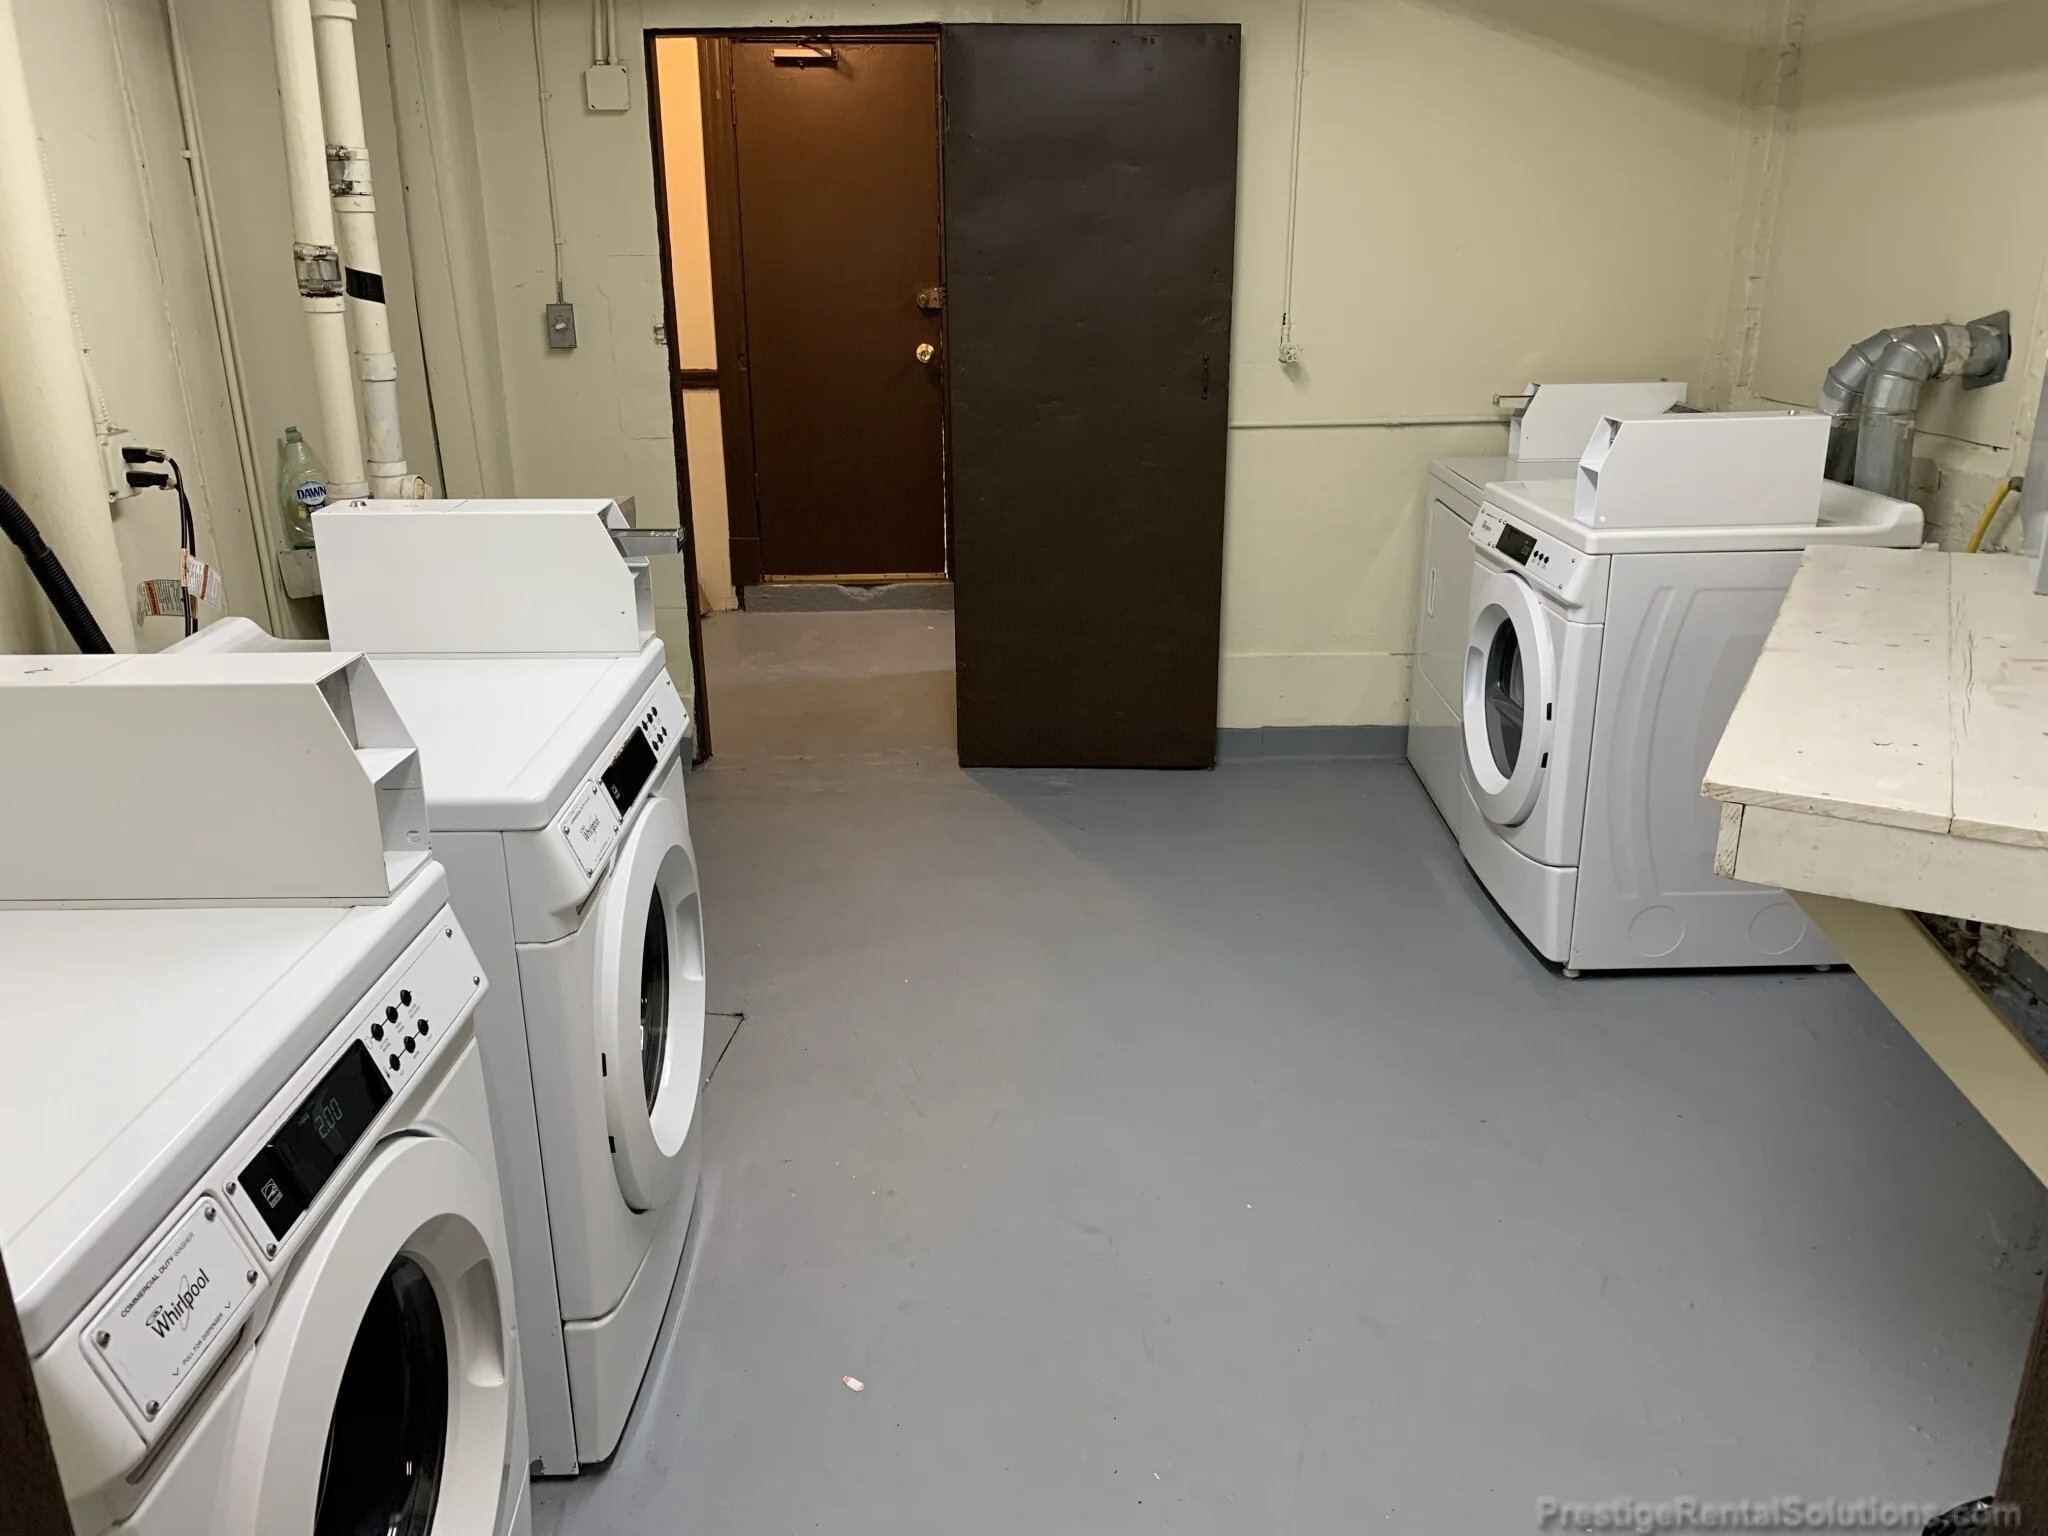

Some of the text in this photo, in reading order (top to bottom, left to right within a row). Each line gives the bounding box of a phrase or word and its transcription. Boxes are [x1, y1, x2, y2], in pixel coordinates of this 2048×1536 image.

[296, 485, 327, 500] DAWN
[315, 1098, 342, 1138] 2.00
[121, 1232, 195, 1317] COMMERCIAL DUTY WASHER
[151, 1268, 210, 1338] Whirlpool
[182, 1313, 224, 1366] PULL FOR DISPENSER
